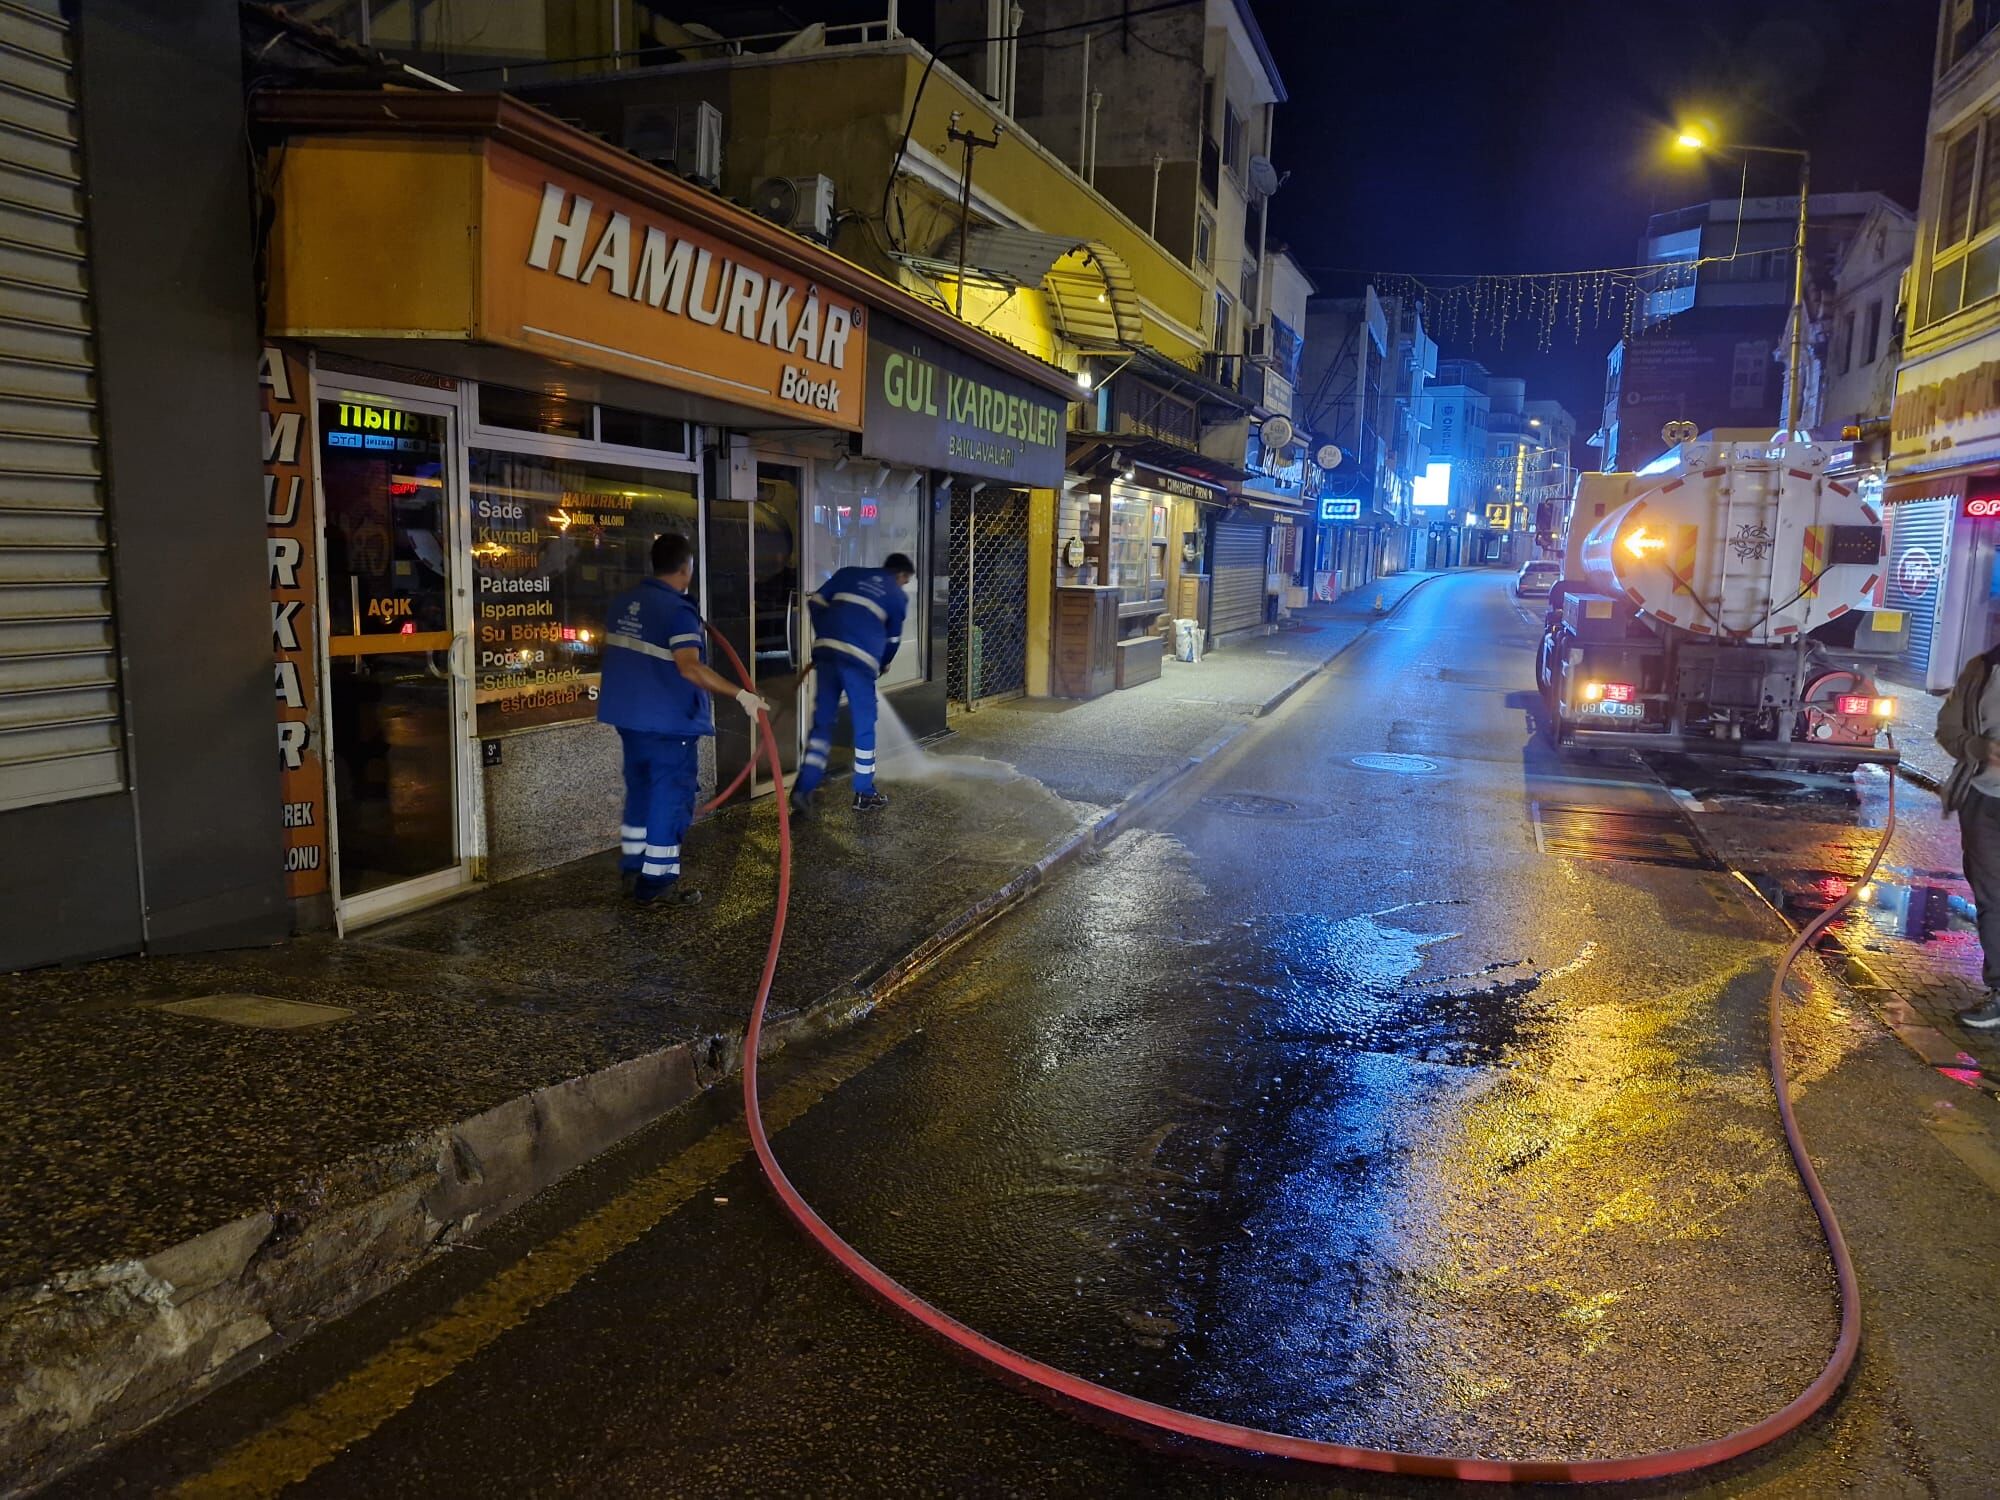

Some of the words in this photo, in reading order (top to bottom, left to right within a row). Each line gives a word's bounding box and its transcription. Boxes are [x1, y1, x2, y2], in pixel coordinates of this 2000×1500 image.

[527, 183, 850, 369] HAMURKÂR
[778, 365, 840, 412] Börek
[884, 345, 938, 416] GÜL
[946, 374, 1058, 453] KARDEŞLER
[949, 435, 1015, 468] BAKLAVALARI
[478, 500, 523, 519] Sade
[478, 527, 539, 547] Kıymalı
[480, 576, 550, 593] Patatesli
[367, 598, 413, 624] AÇIK
[481, 600, 553, 620] Ispanaklı
[481, 625, 505, 642] Su
[511, 621, 562, 642] Böreği
[482, 647, 545, 669] Poğaça
[483, 672, 529, 691] Sütlü
[534, 665, 581, 685] Börek
[1599, 702, 1616, 714] KJ
[1619, 704, 1642, 716] 585
[282, 803, 313, 827] REK
[284, 846, 319, 870] ONU
